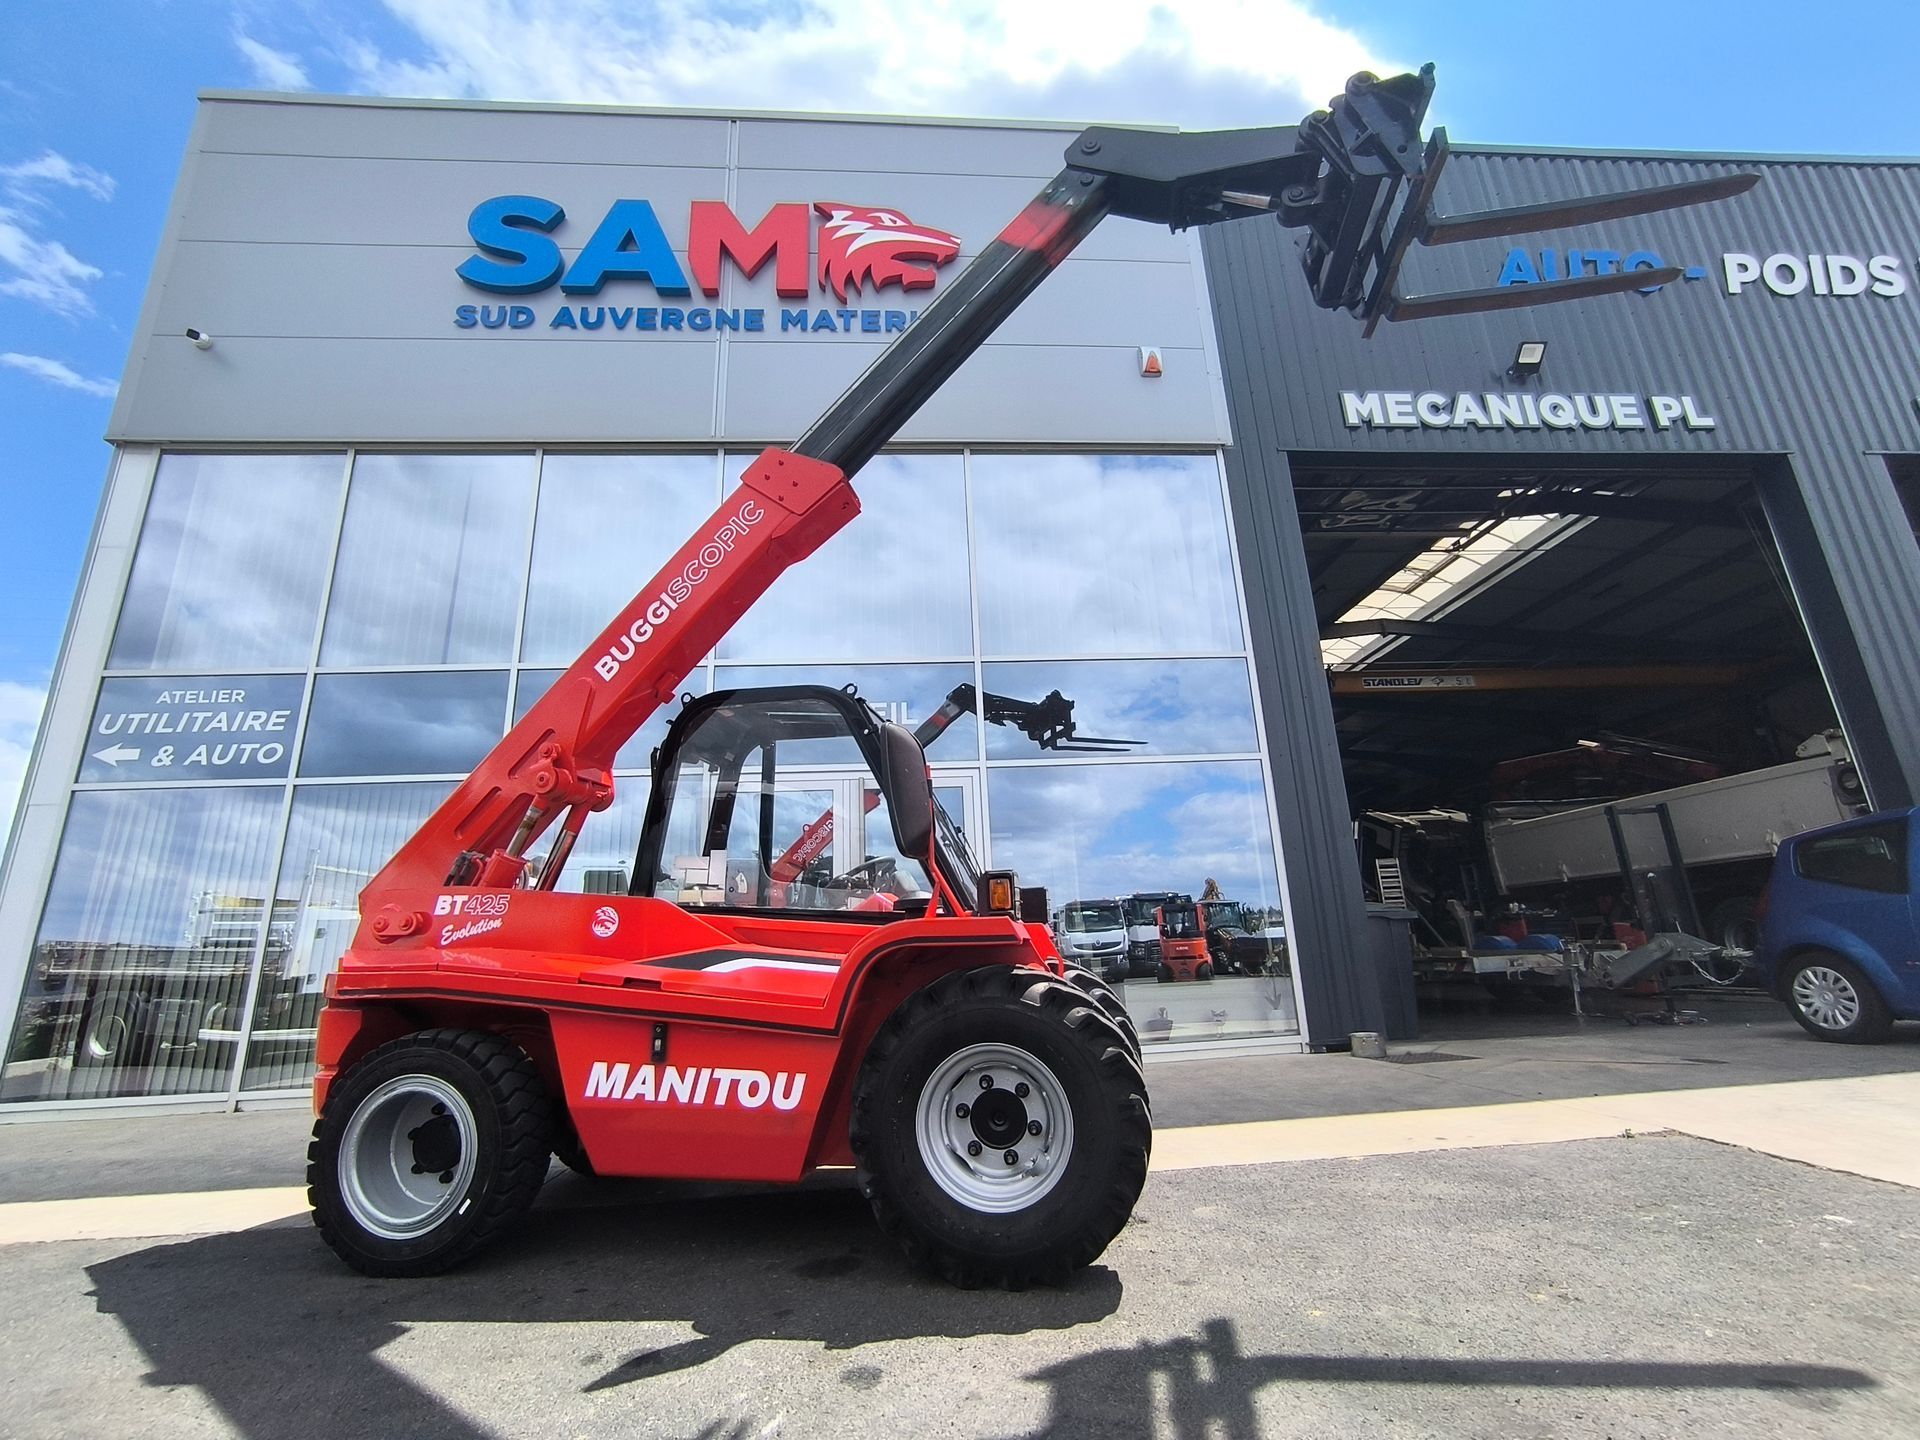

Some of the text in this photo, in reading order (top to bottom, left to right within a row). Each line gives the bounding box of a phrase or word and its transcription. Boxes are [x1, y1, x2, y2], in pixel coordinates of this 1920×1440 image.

[455, 195, 809, 298] SAM
[1723, 253, 1906, 296] POIDS
[454, 305, 535, 329] SUD
[550, 306, 764, 332] AUVERGNE
[1341, 391, 1716, 430] MECANIQUE PL
[594, 501, 764, 682] BUGGISCOPIC
[156, 690, 246, 704] ATELIER
[98, 710, 292, 735] UTILITAIRE
[150, 742, 284, 767] & AUTO
[434, 894, 510, 916] BT425
[440, 918, 504, 946] Evolution
[584, 1061, 807, 1110] MANITOU
